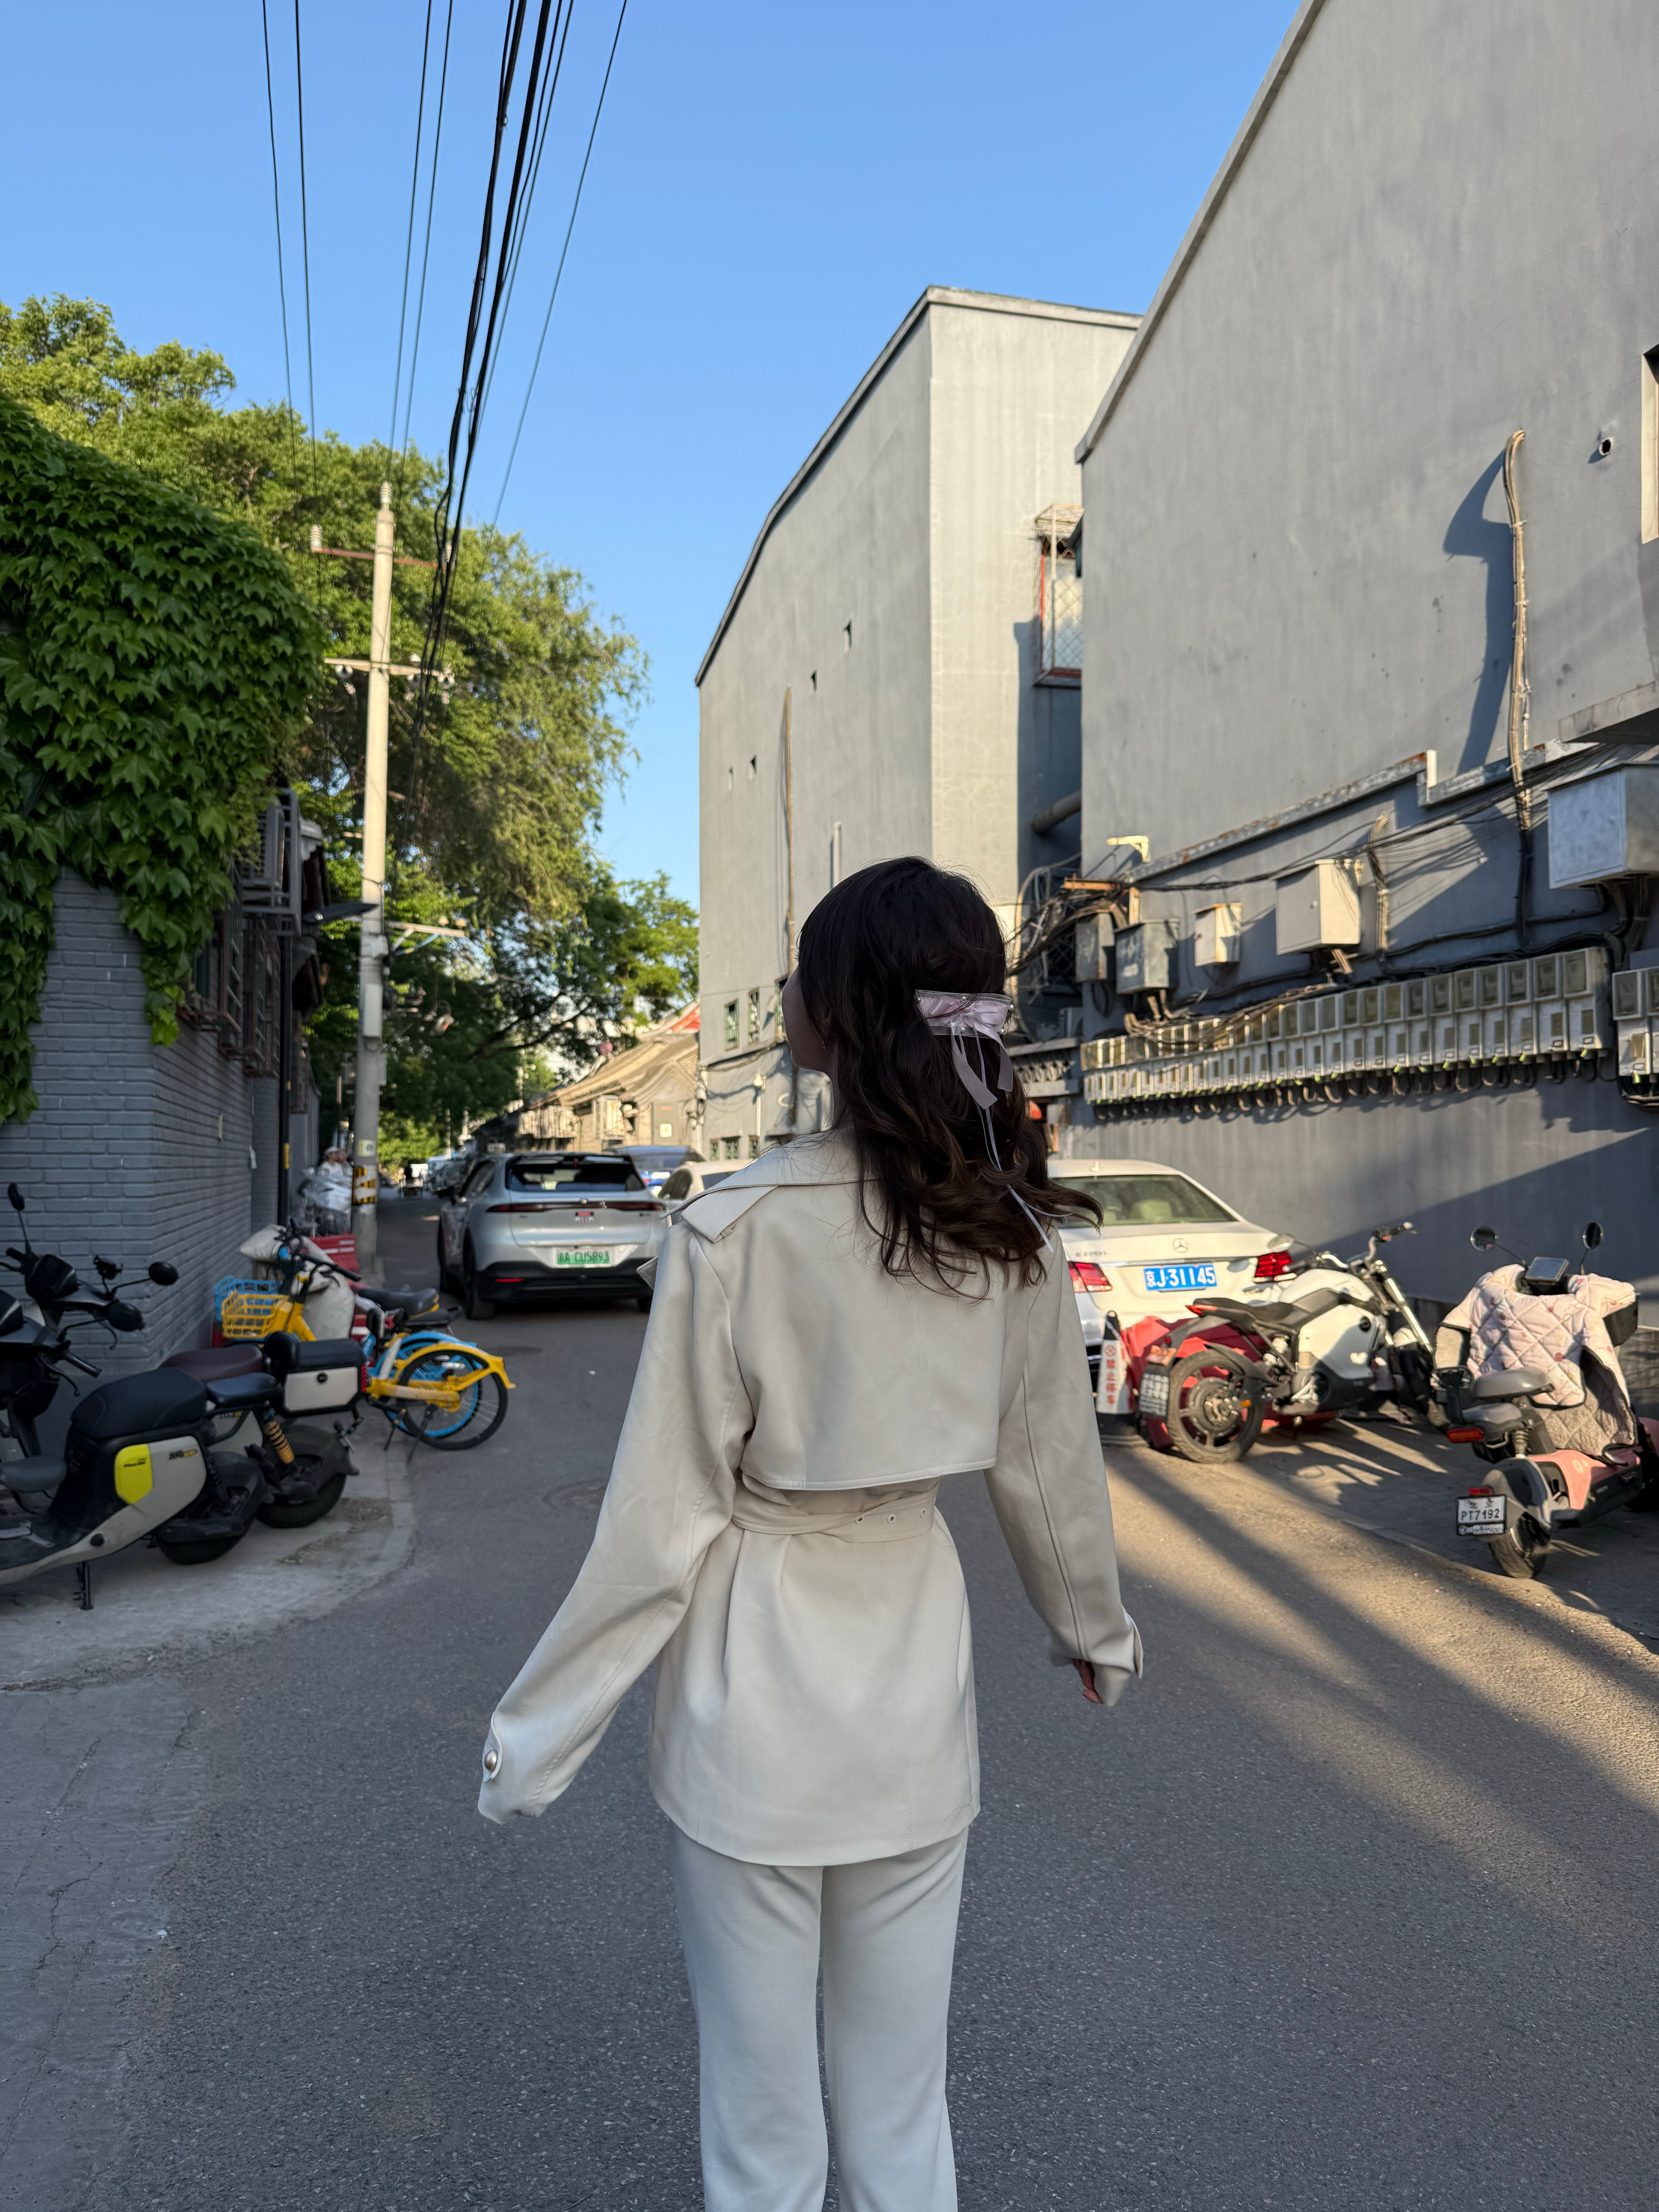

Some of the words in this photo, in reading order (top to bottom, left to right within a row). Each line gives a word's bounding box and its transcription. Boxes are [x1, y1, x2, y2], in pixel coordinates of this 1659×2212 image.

[1106, 1359, 1115, 1405] 禁止停车
[1461, 1508, 1499, 1520] PT7192
